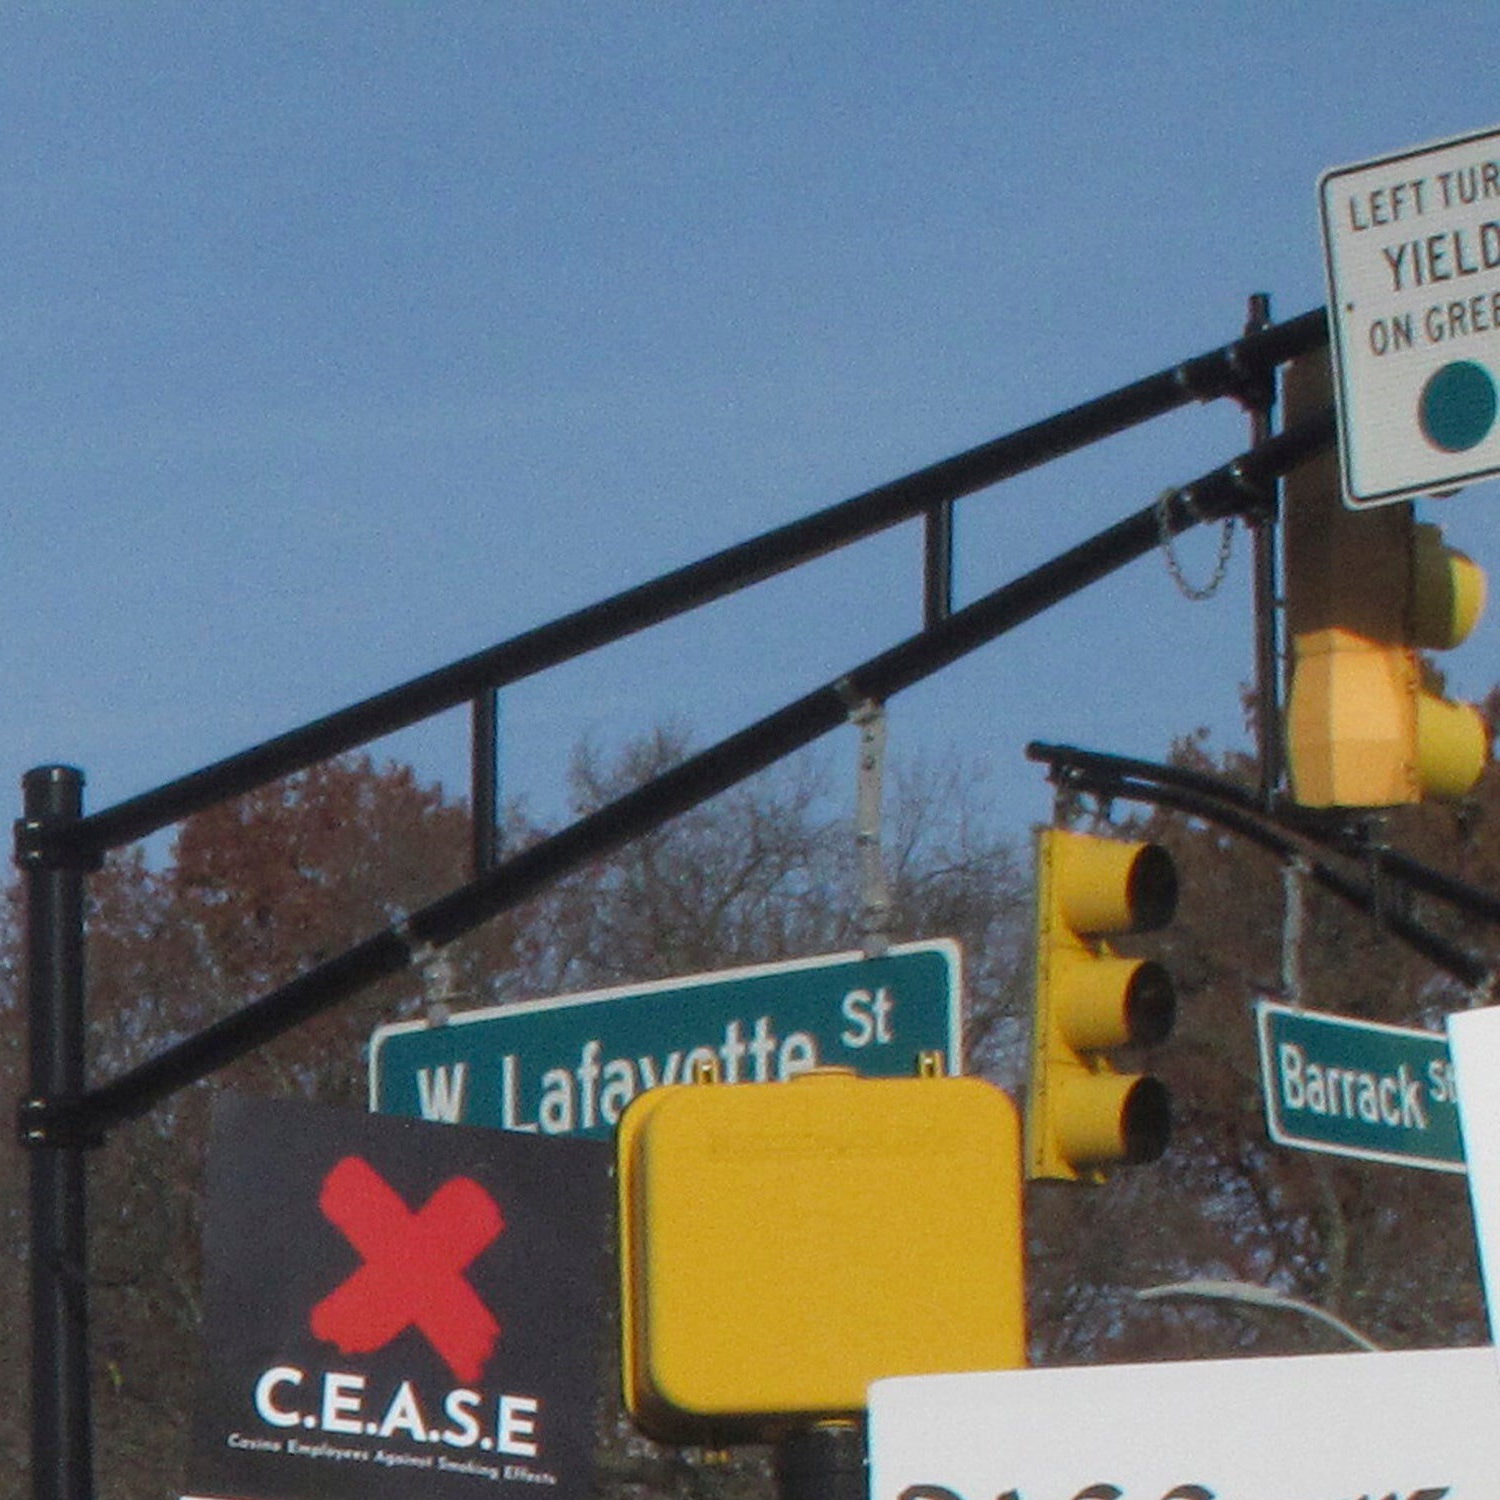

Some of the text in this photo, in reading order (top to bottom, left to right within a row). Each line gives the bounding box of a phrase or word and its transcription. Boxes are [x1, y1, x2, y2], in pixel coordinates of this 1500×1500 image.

[1349, 162, 1500, 231] LEFT TUR
[1381, 220, 1500, 291] YIELD
[1369, 293, 1500, 356] ON GREE
[417, 1062, 468, 1124] W
[842, 987, 894, 1047] St
[1278, 1042, 1428, 1130] Barrack
[255, 1366, 539, 1458] C.E.A.S.E
[227, 1432, 282, 1453] Casino
[286, 1438, 370, 1463] Employees
[437, 1455, 501, 1480] Smoking
